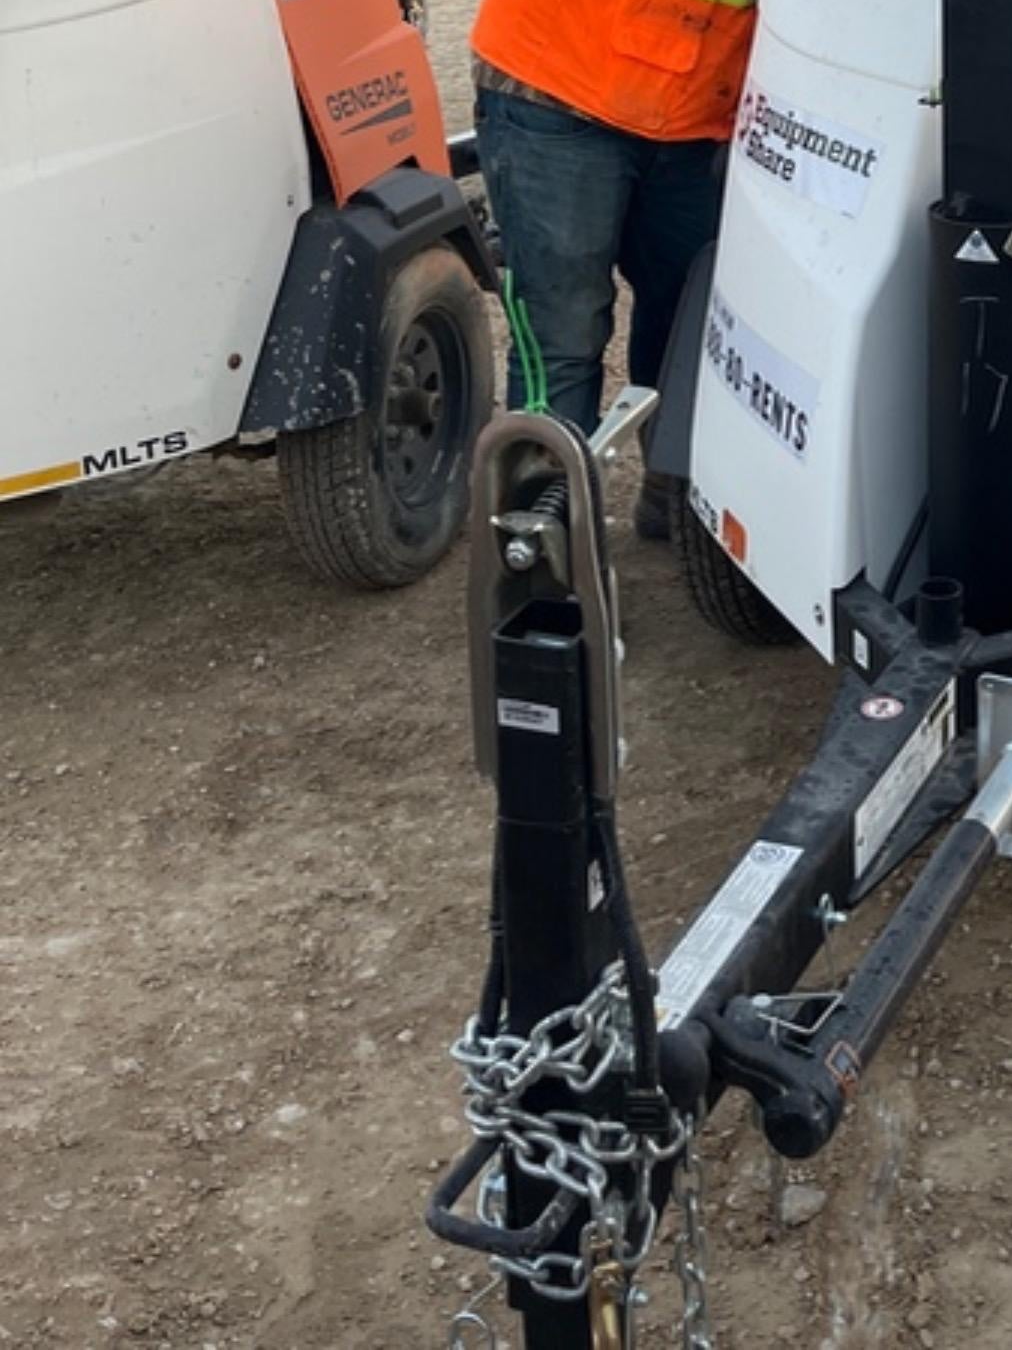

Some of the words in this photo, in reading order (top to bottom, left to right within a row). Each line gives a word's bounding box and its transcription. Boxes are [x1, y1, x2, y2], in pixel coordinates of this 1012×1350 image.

[326, 71, 409, 122] GENERAC
[756, 94, 877, 178] Equipment
[82, 431, 188, 475] MLTS
